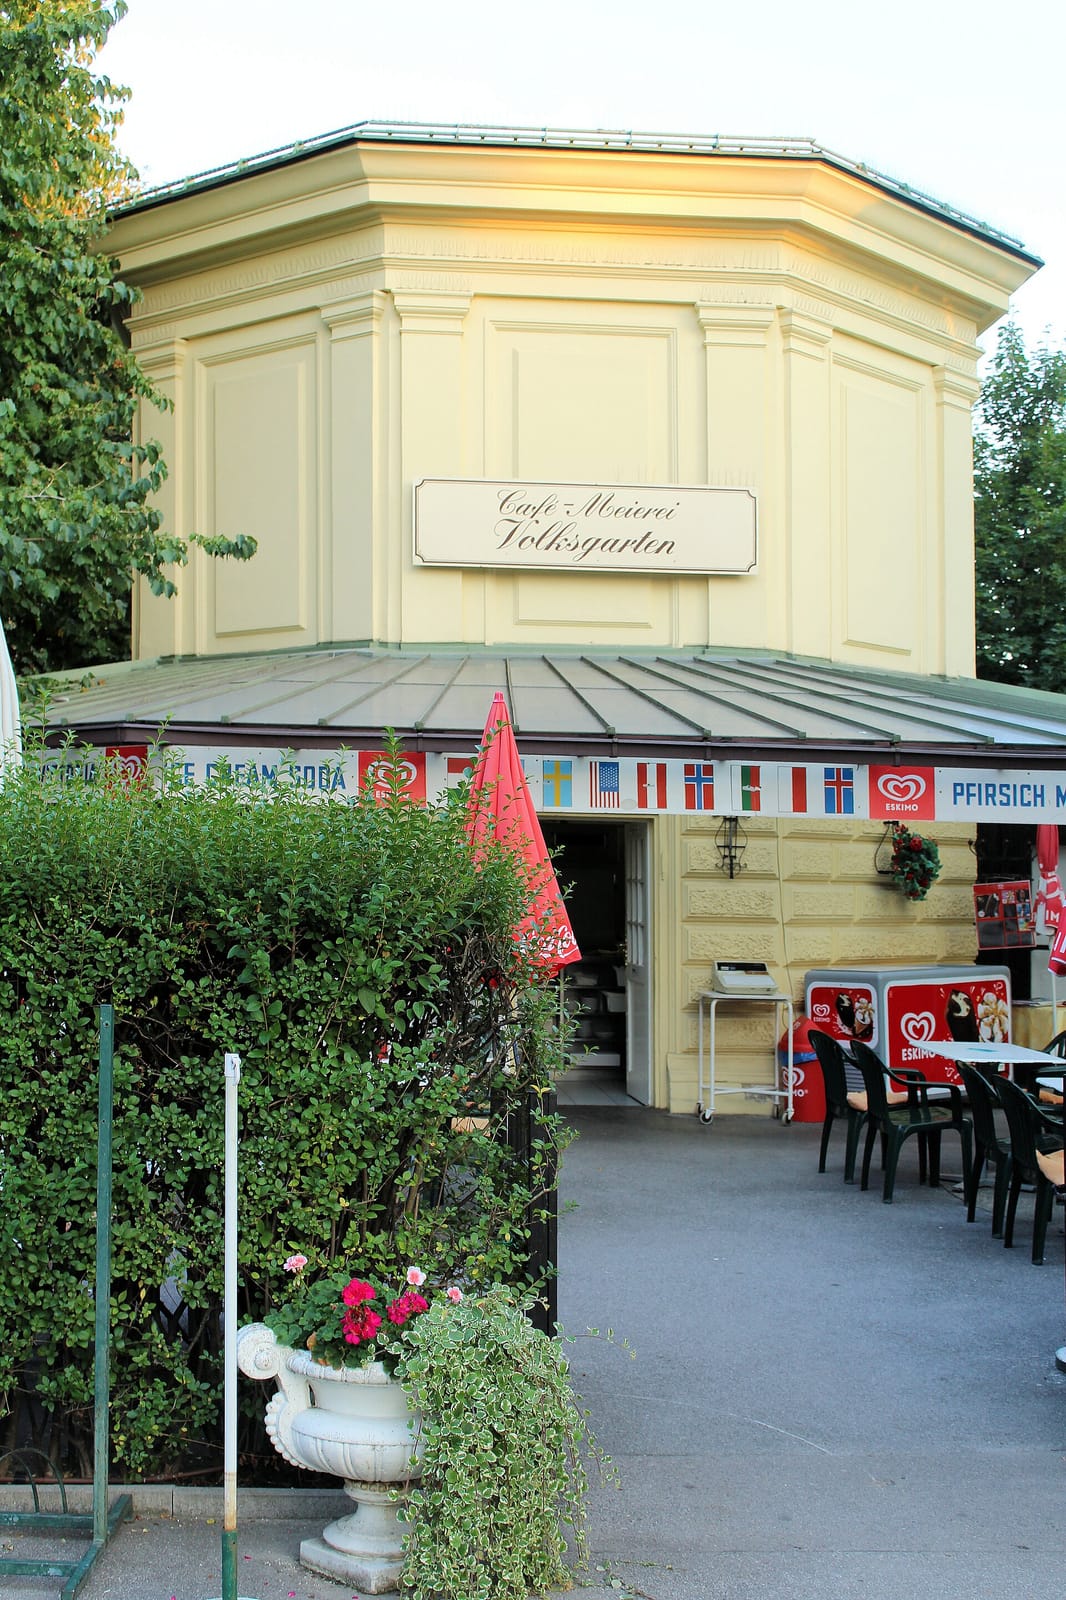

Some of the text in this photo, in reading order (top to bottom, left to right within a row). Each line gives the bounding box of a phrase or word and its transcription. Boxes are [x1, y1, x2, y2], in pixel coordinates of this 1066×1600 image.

[494, 518, 677, 562] Volksgarten
[953, 782, 1045, 807] PFIRSICH
[885, 803, 919, 812] ESKIMO
[901, 1047, 936, 1061] ESKIMO
